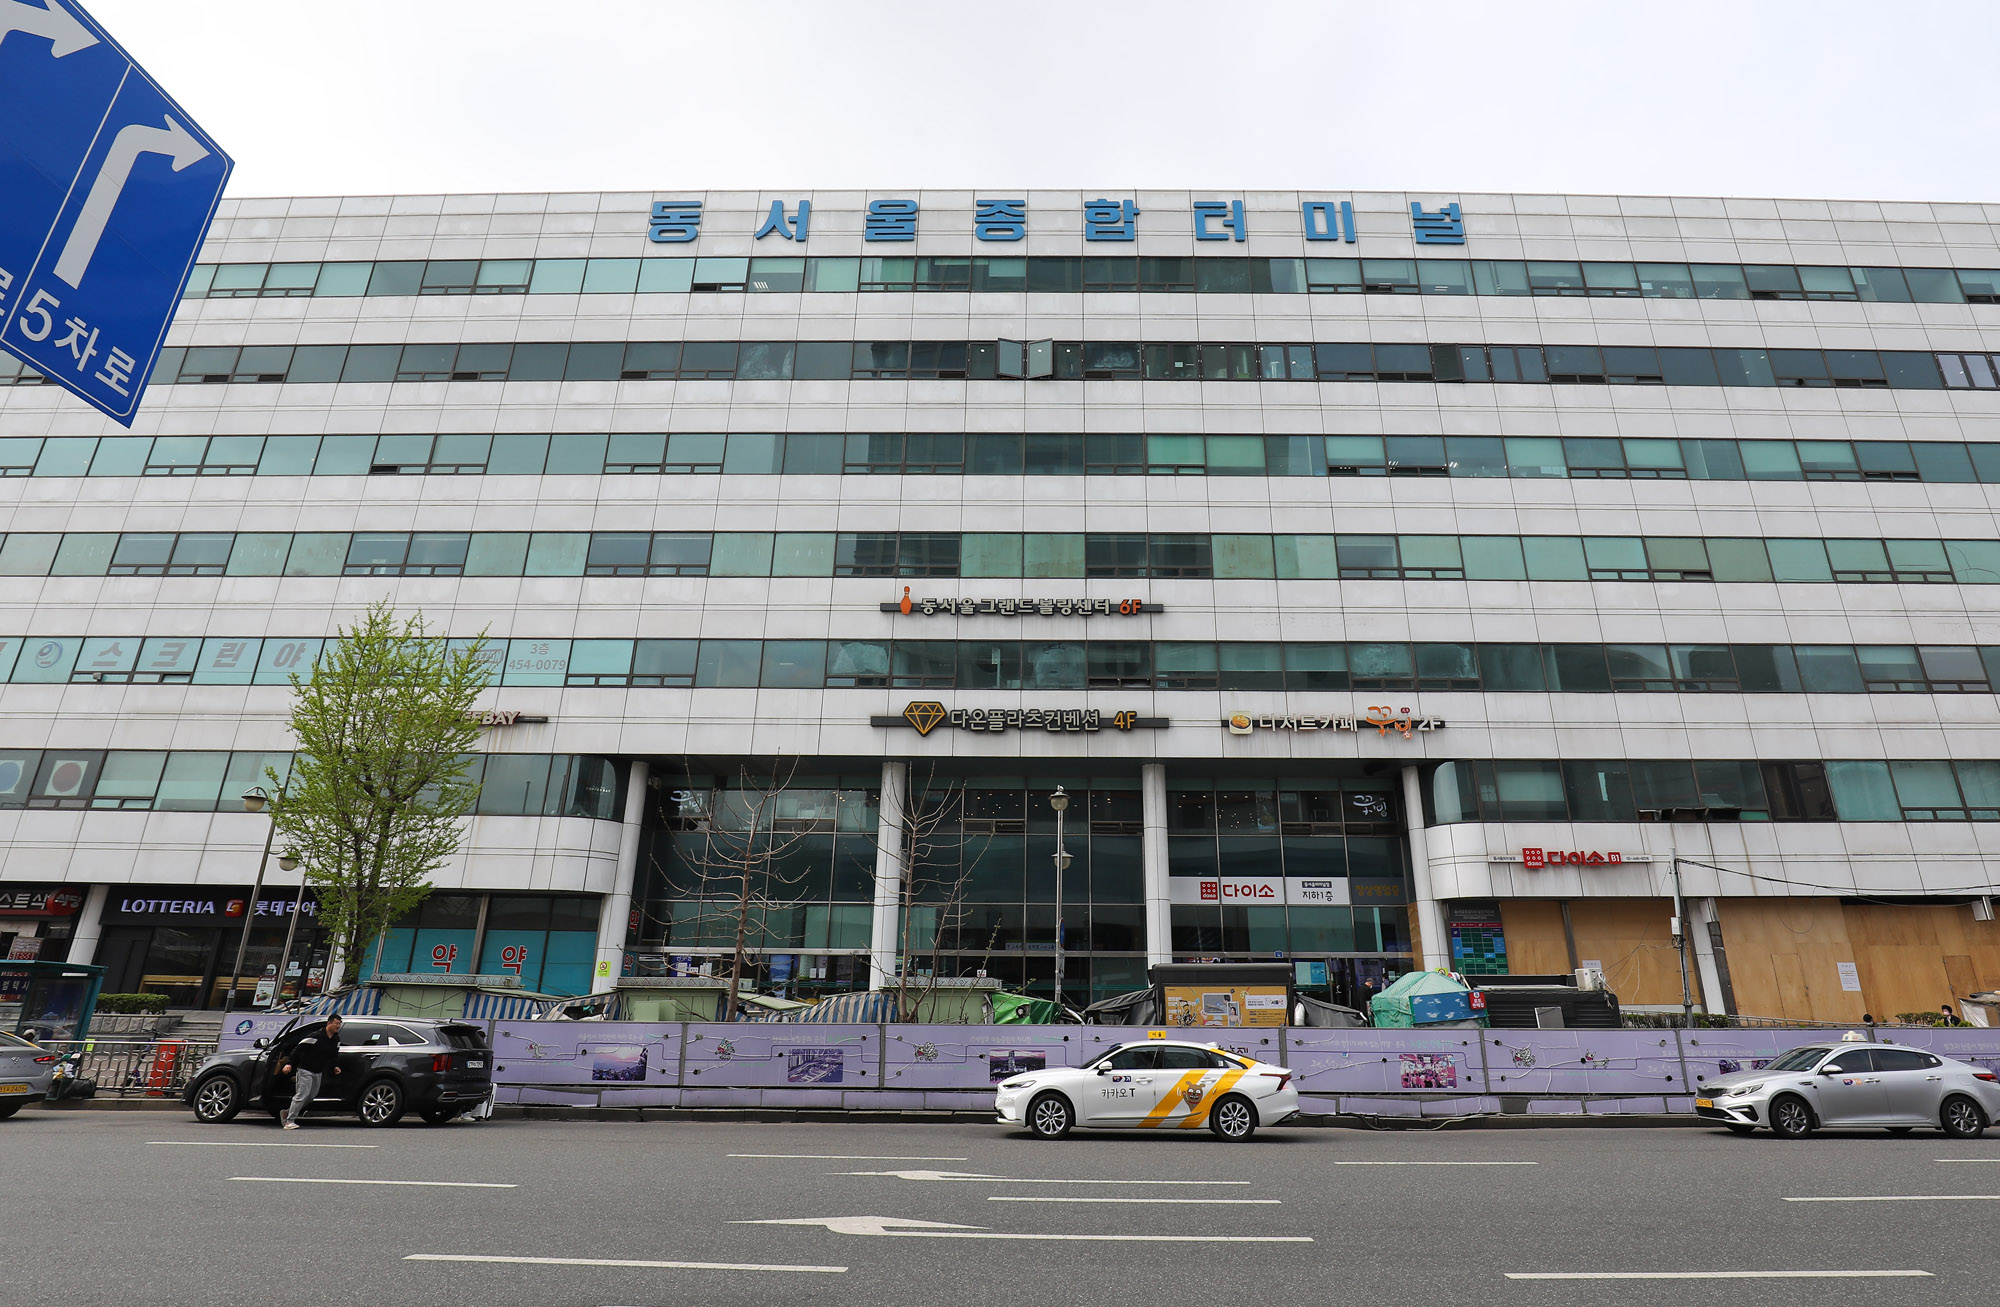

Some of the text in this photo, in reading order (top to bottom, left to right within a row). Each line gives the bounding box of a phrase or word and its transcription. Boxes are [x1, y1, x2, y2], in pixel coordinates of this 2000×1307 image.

[649, 199, 1465, 244] 동서울종합터미널
[19, 288, 136, 398] 5차로
[1119, 598, 1142, 615] 6F
[530, 642, 551, 655] 3층
[508, 659, 567, 671] 454-0079
[949, 708, 1137, 731] 다온플라츠컨벤션 4F
[1417, 714, 1441, 732] 2F
[1547, 850, 1620, 867] 다이소 B1
[1222, 884, 1274, 898] 다이소
[1302, 890, 1334, 902] 지하1층
[120, 899, 216, 914] LOTTERIA
[431, 944, 458, 974] 약
[501, 945, 528, 976] 약
